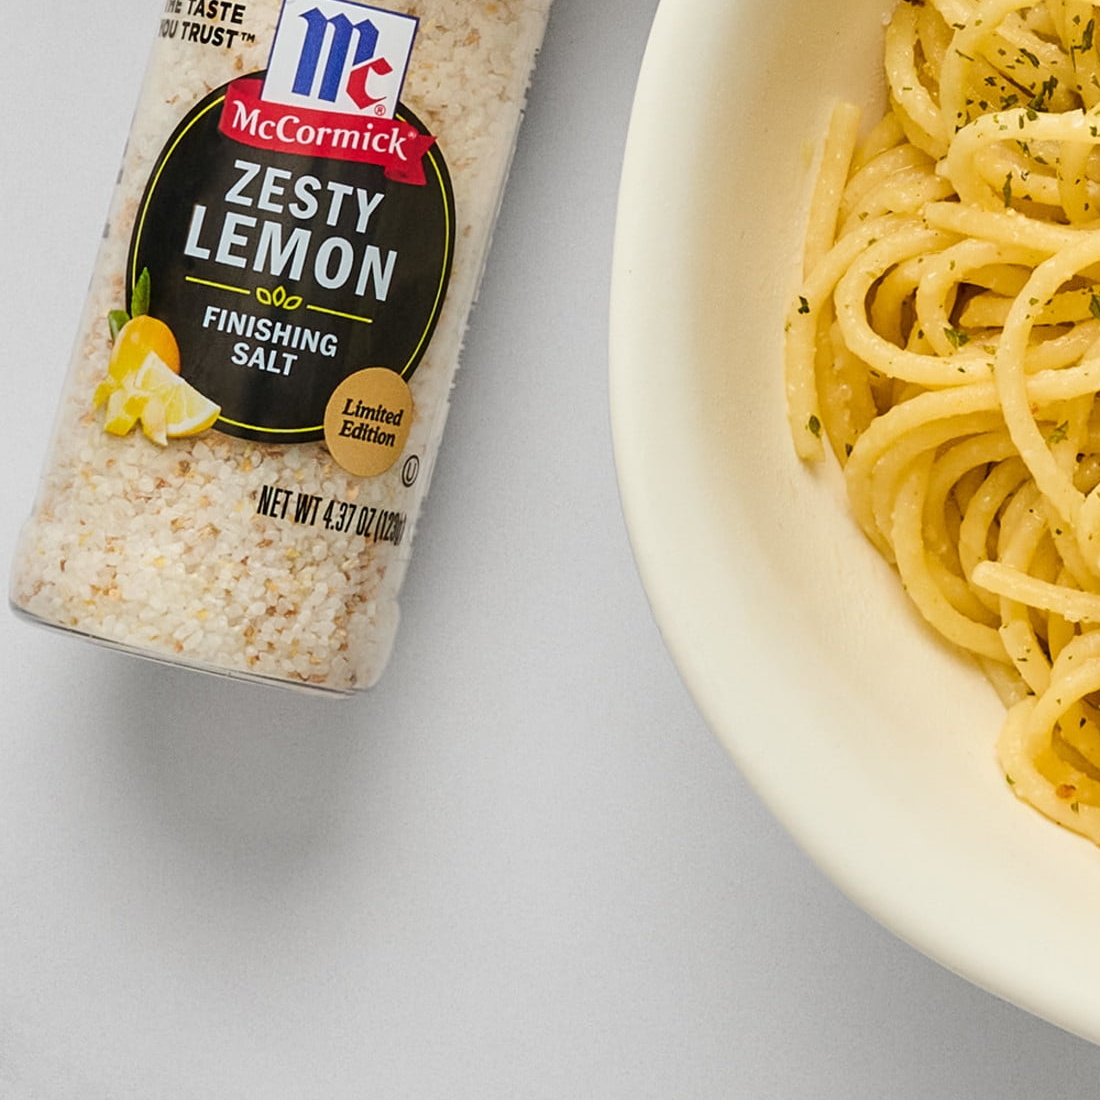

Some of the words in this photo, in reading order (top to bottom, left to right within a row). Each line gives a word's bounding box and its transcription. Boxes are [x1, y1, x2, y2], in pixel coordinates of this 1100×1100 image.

[225, 160, 385, 233] ZESTY
[184, 204, 398, 302] LEMON
[203, 306, 338, 357] FINISHING
[231, 343, 298, 376] SALT
[338, 420, 396, 447] Edition
[341, 398, 404, 427] Limited
[257, 485, 293, 520] NET
[294, 492, 323, 526] WT
[322, 500, 357, 534] 4.37
[356, 506, 377, 538] OZ
